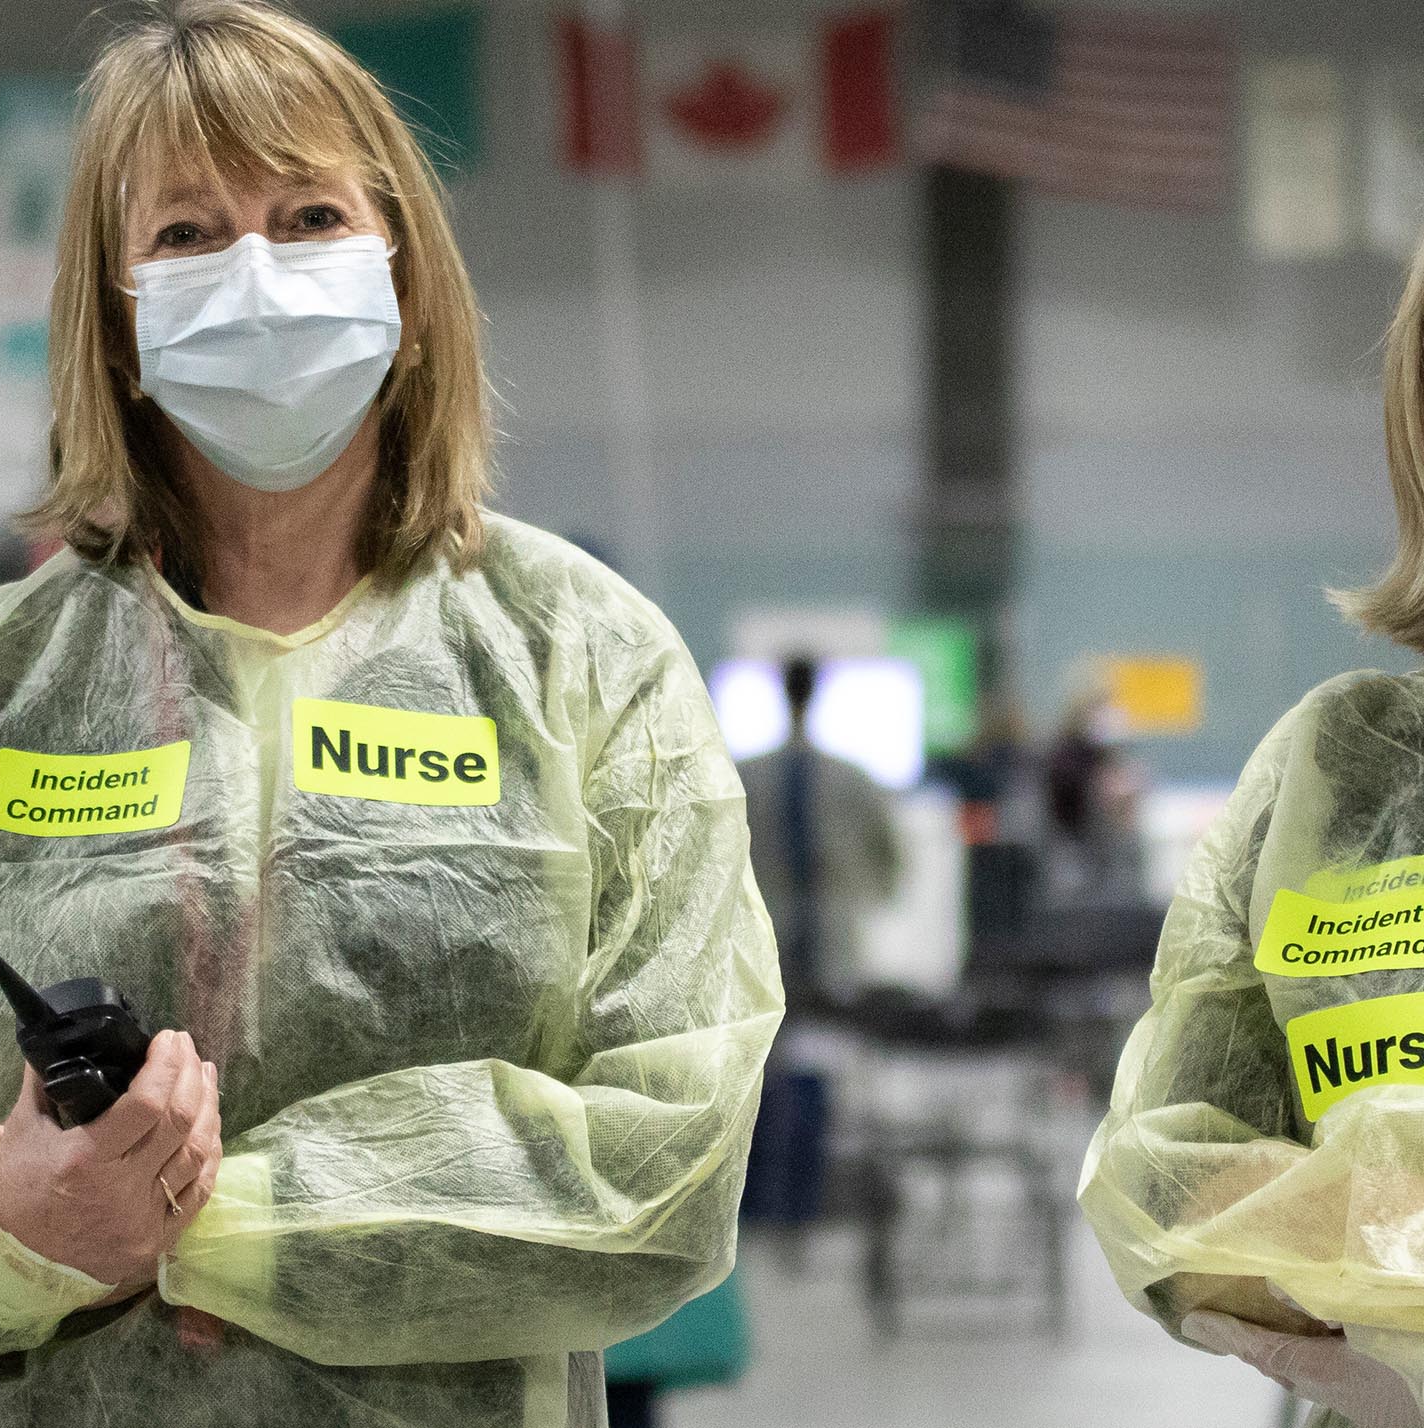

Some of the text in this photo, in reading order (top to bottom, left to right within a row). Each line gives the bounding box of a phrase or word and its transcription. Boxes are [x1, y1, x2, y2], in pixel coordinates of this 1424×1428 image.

[311, 726, 488, 784] Nurse
[30, 766, 151, 791] Incident
[7, 794, 159, 823] Command
[1307, 905, 1424, 935] Incident
